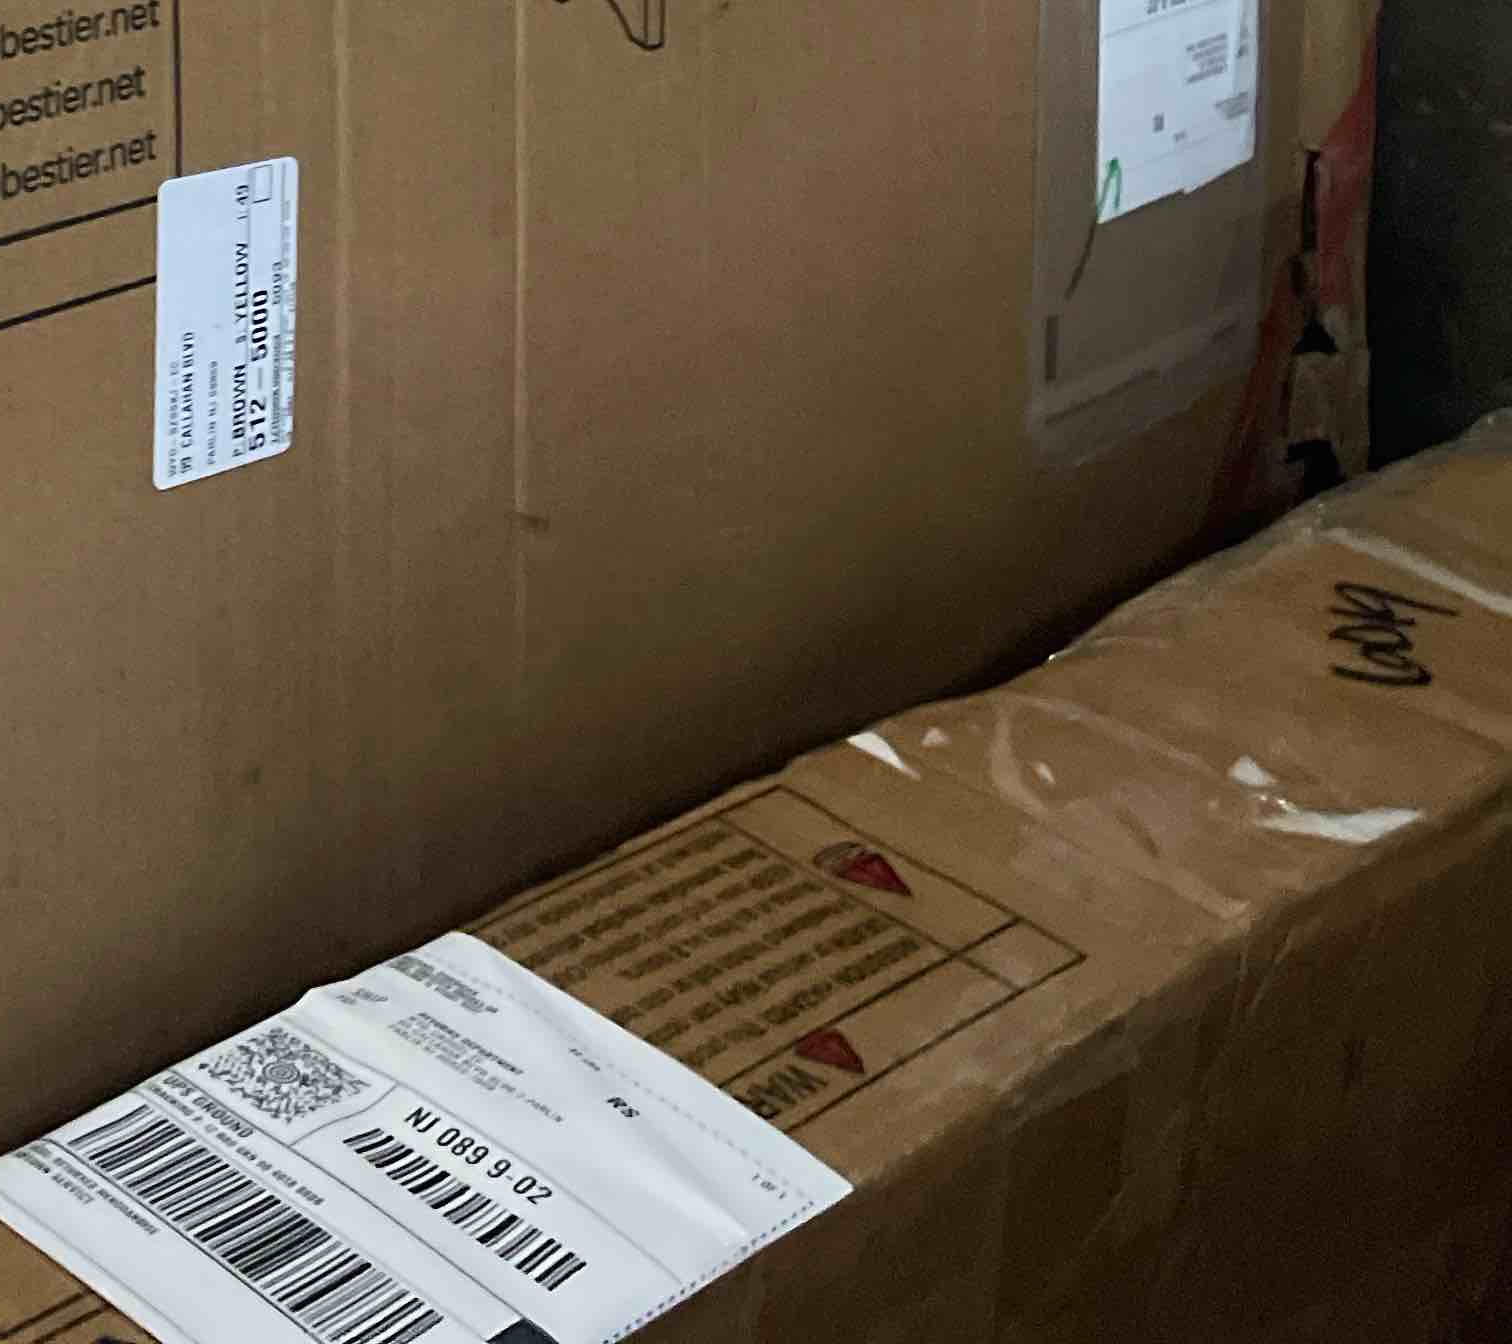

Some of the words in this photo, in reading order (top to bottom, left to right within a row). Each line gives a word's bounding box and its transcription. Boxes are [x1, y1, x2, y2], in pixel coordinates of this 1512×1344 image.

[233, 240, 248, 323] YELLOW
[249, 288, 268, 362] 5000
[231, 362, 246, 440] BROWN
[247, 395, 266, 451] 512
[192, 1096, 254, 1138] GROUND
[403, 1106, 441, 1133] NJ
[436, 1127, 489, 1165] 089
[486, 1159, 552, 1205] 9-02
